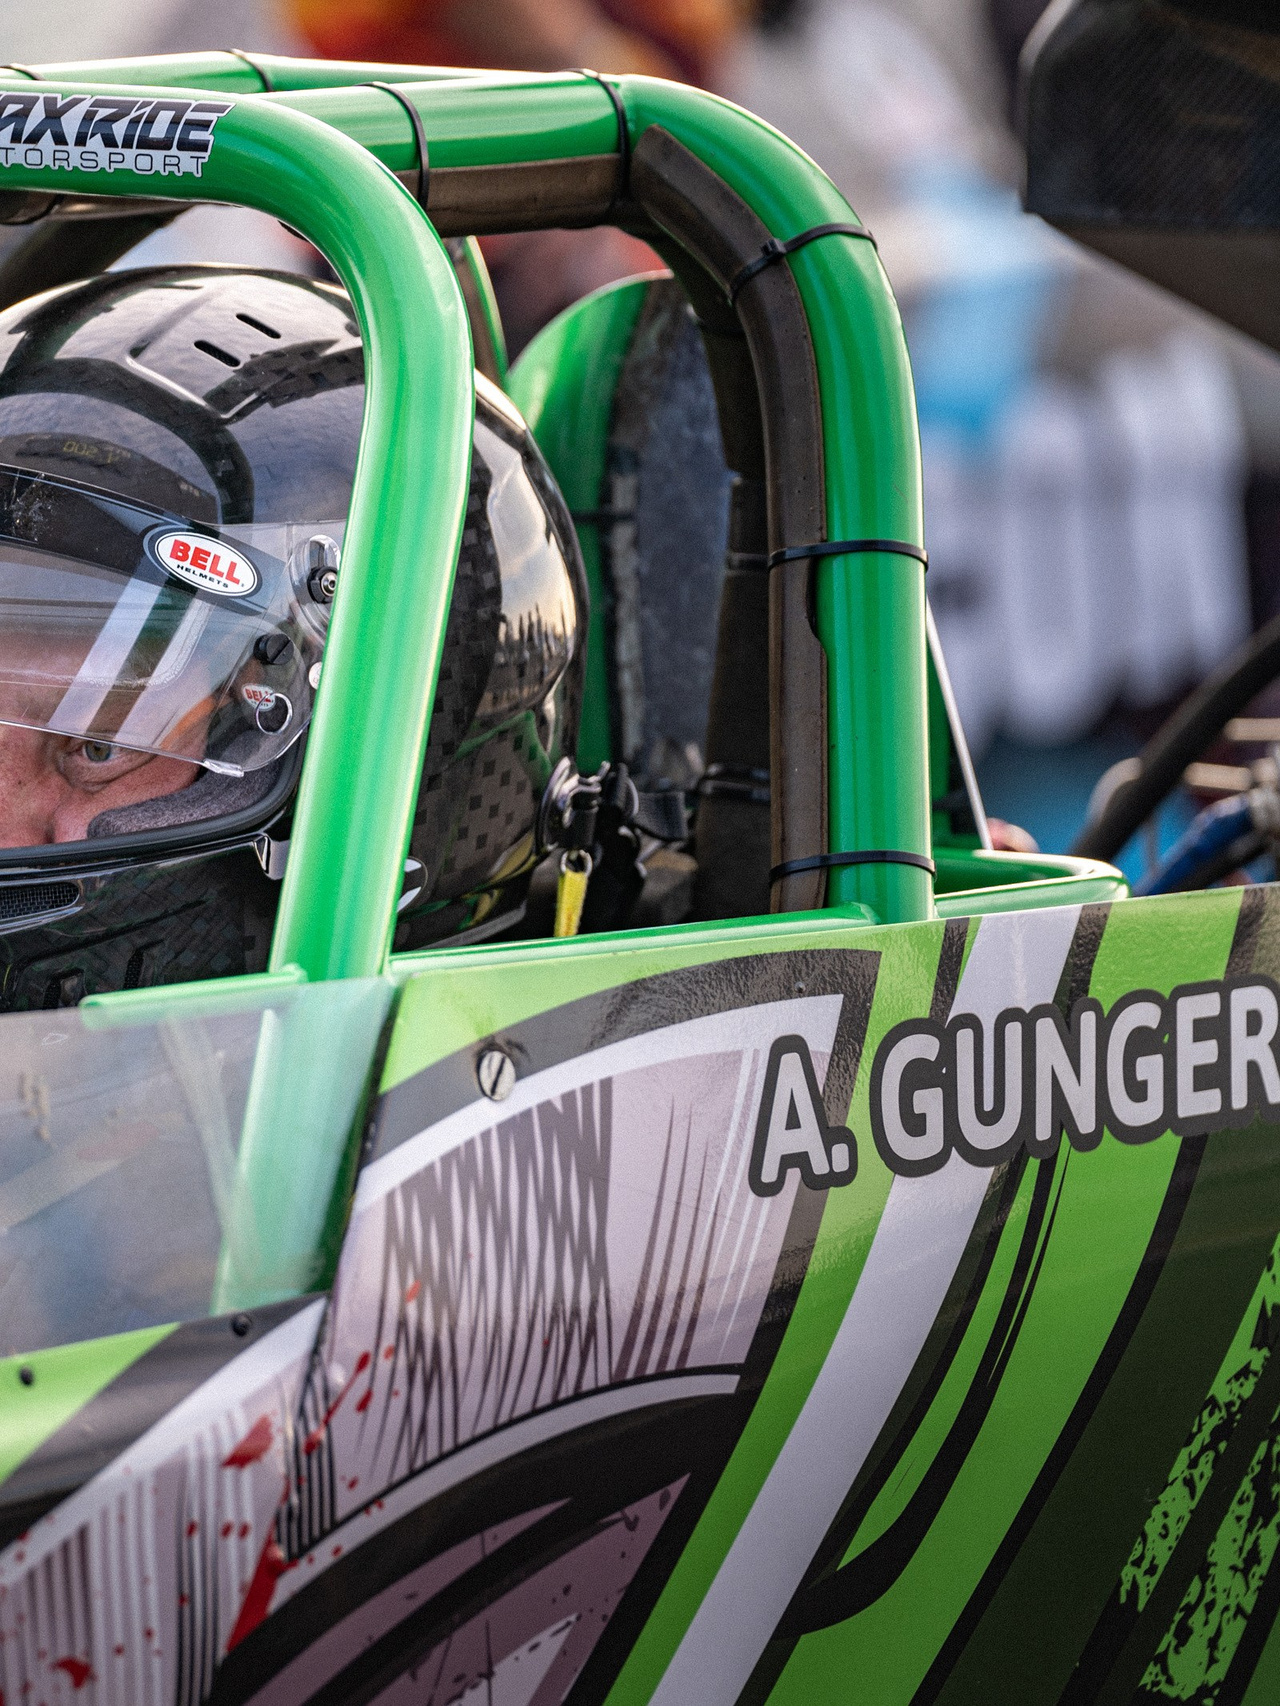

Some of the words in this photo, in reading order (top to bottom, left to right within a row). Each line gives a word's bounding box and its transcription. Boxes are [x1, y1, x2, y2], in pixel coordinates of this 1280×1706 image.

[169, 538, 241, 585] BELL
[176, 563, 229, 589] HELMETS
[756, 1046, 853, 1189] A.
[875, 981, 1280, 1168] GUNGER
